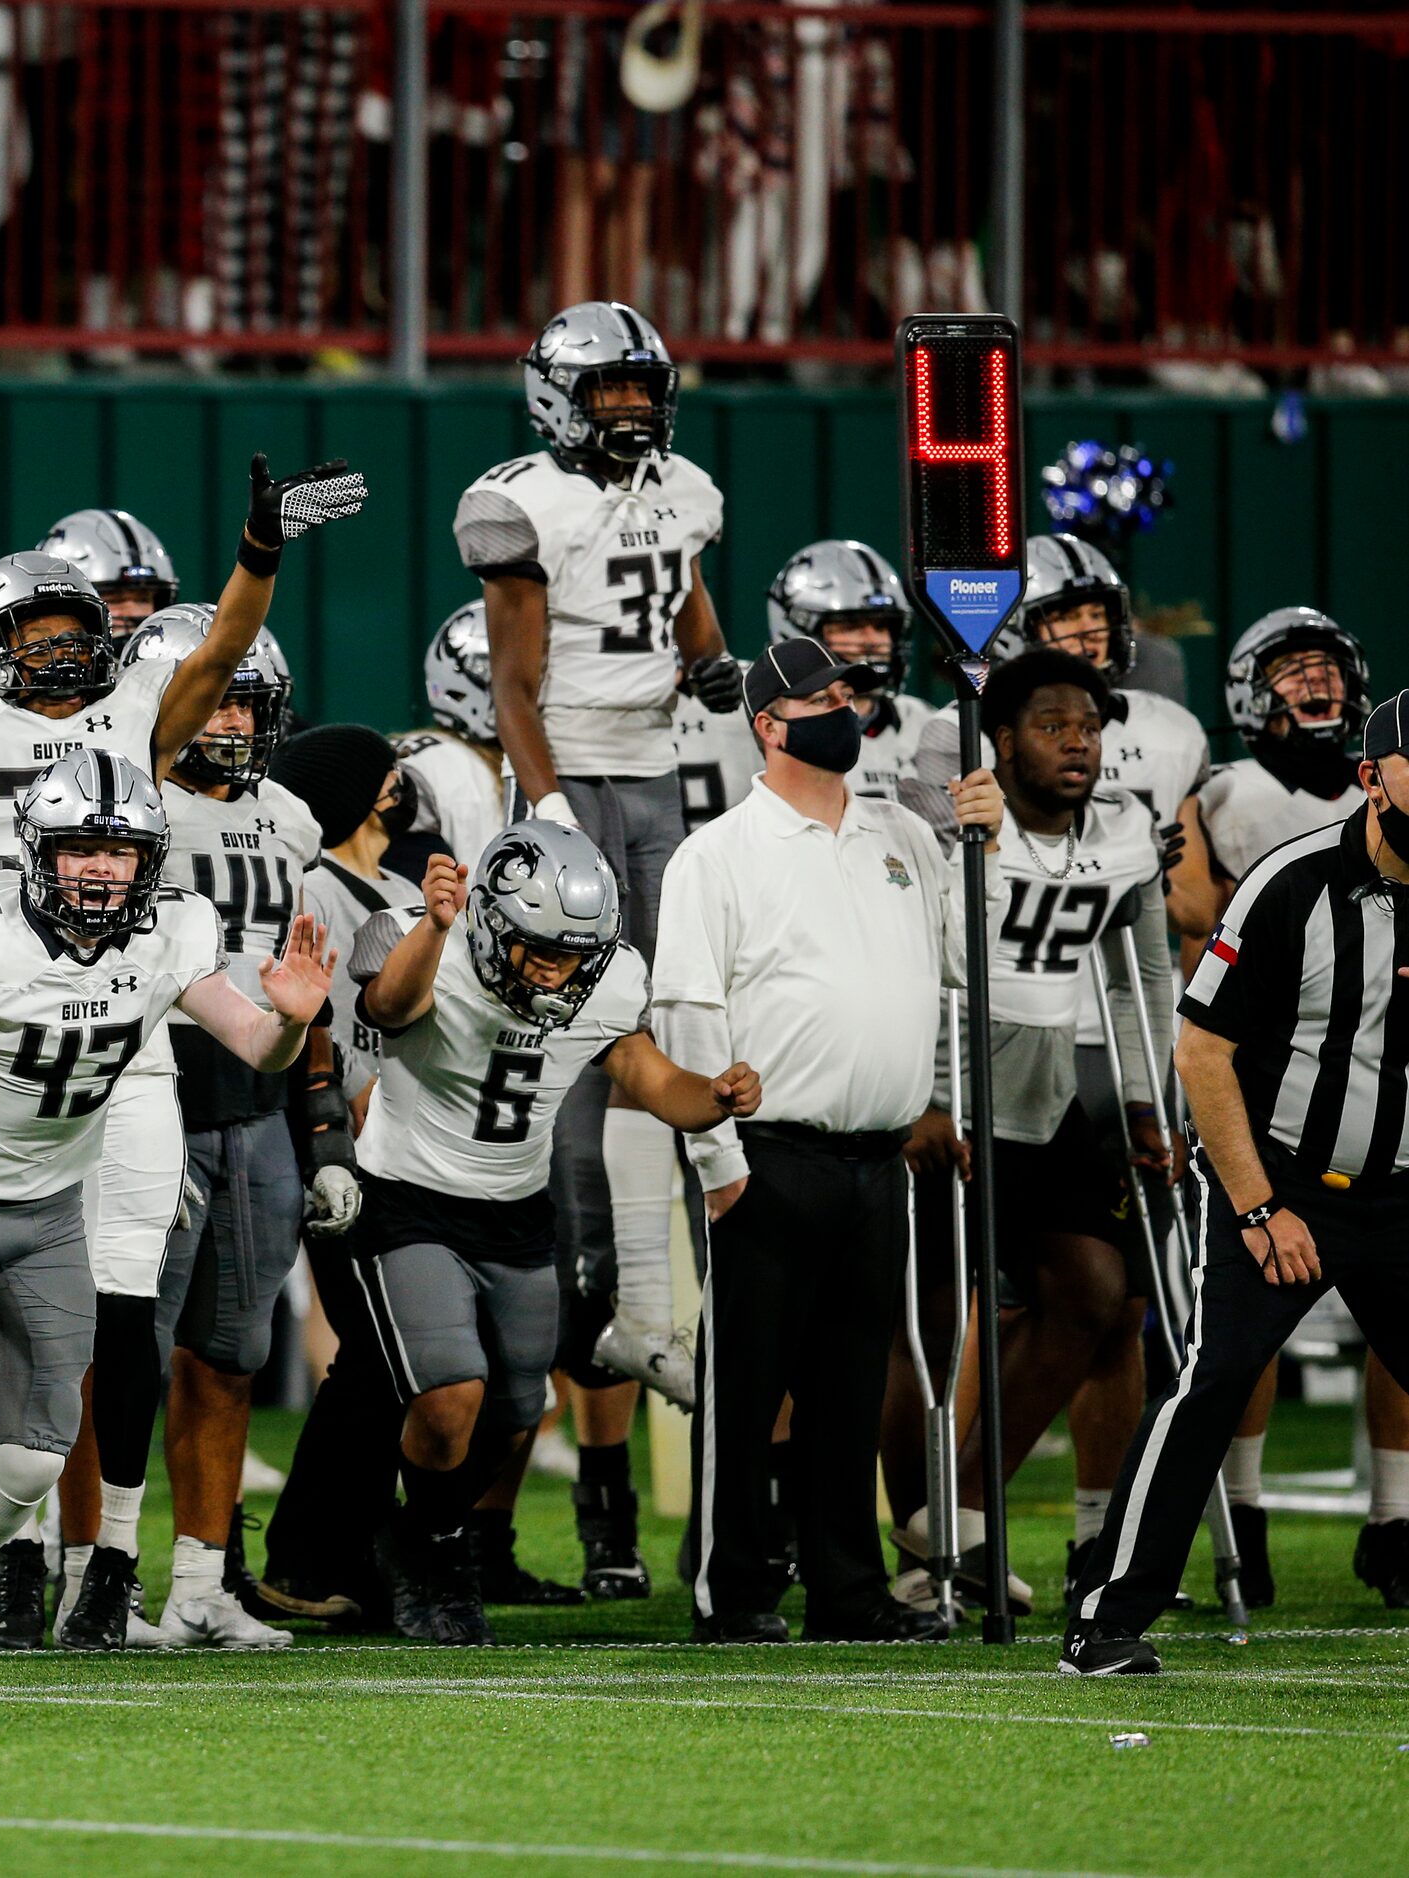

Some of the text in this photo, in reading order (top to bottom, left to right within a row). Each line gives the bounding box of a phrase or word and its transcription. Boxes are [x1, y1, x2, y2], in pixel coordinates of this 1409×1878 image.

[917, 348, 1010, 556] 4
[620, 530, 660, 547] GUYER
[600, 550, 682, 653] 31
[950, 579, 998, 594] Pioneer
[221, 832, 260, 850] GUYER
[192, 854, 294, 961] 44
[1000, 877, 1111, 974] 42
[62, 1000, 109, 1021] GUYER
[496, 1030, 544, 1049] GUYER
[9, 1016, 144, 1119] 43
[472, 1049, 545, 1143] 6
